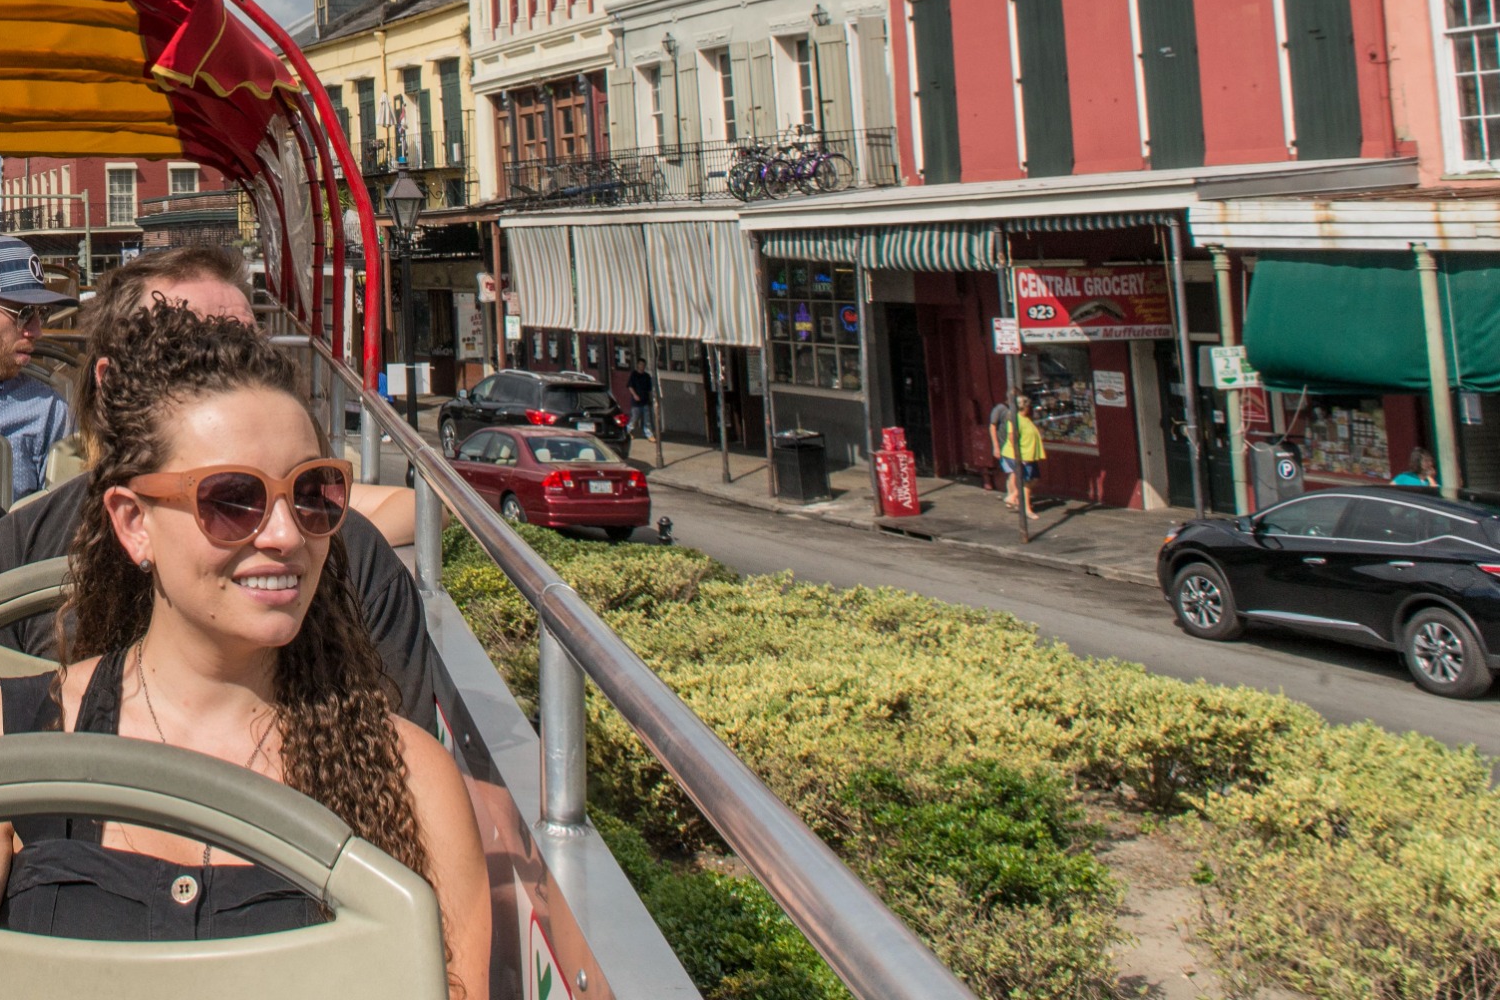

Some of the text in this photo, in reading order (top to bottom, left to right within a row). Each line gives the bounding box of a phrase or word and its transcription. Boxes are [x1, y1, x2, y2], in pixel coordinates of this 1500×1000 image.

[1018, 272, 1081, 298] CENTRAL
[1084, 272, 1146, 297] GROCERY
[1028, 306, 1055, 319] 923
[1102, 327, 1170, 338] Muffuletta
[1223, 358, 1230, 368] 2
[896, 453, 913, 509] ADVOCATE
